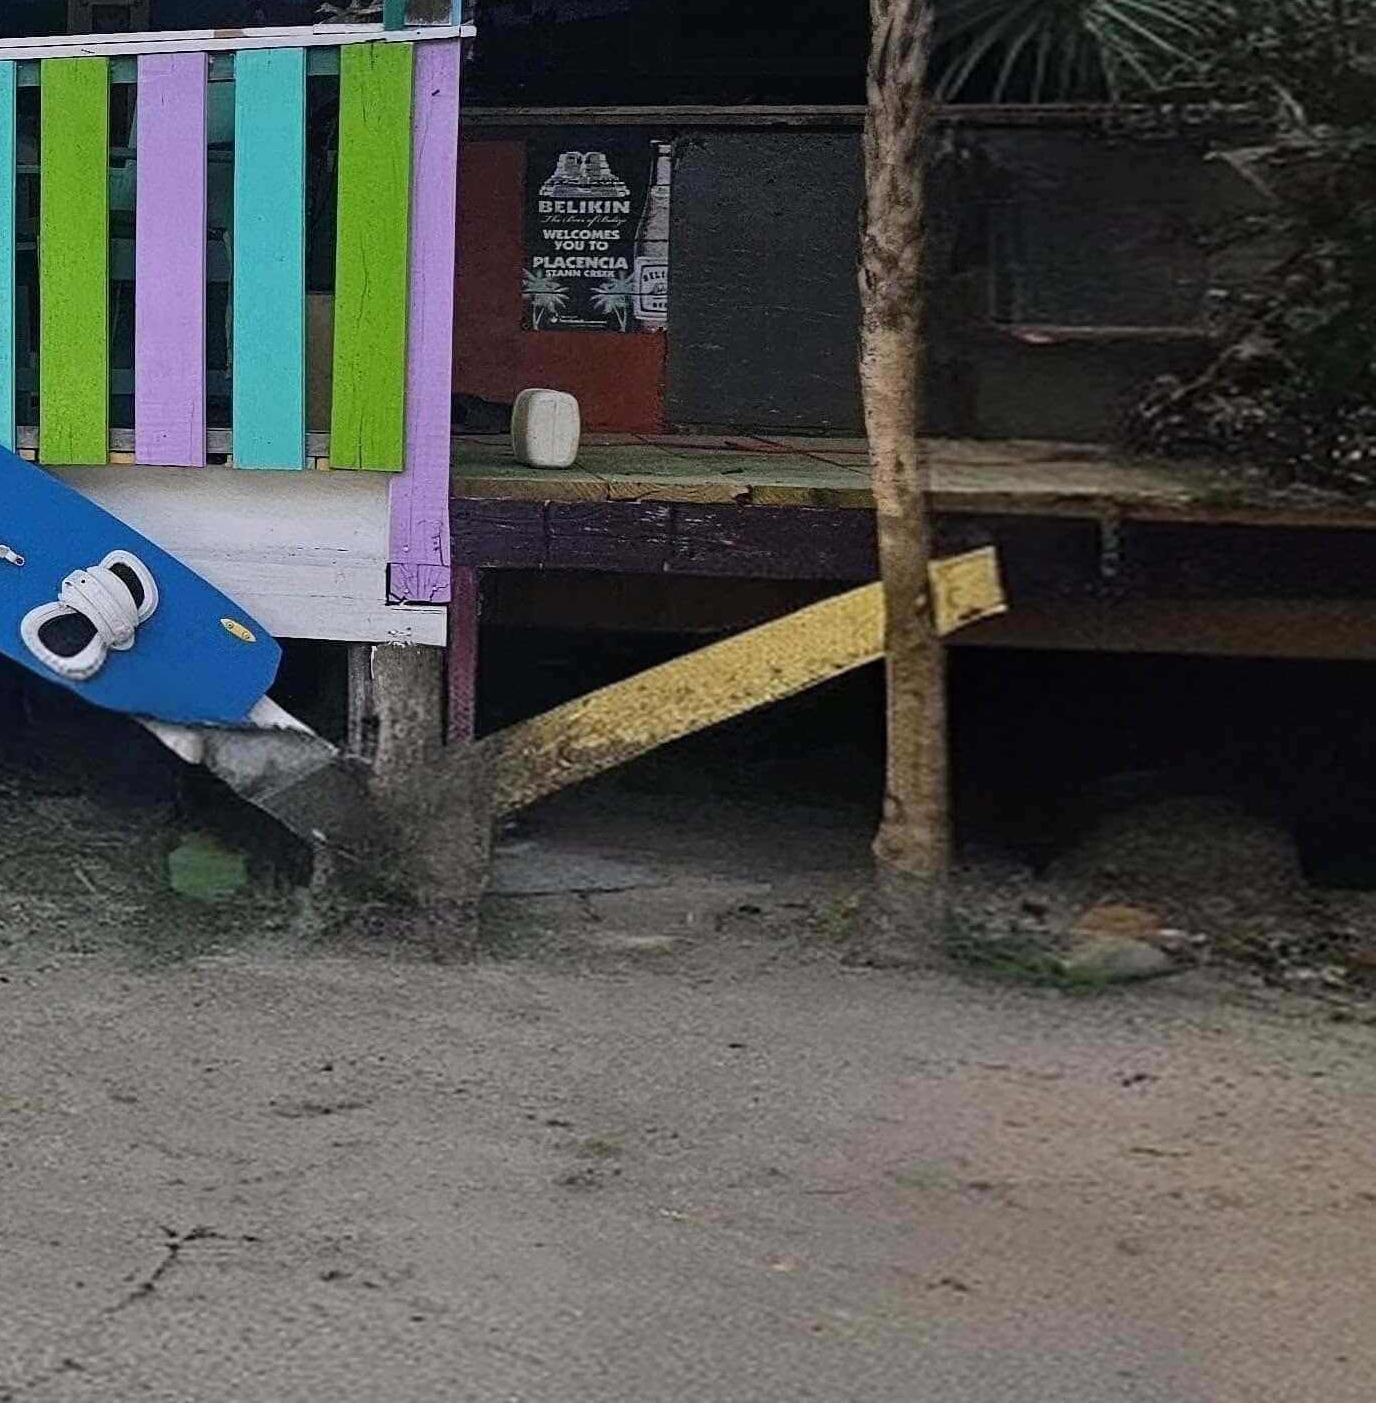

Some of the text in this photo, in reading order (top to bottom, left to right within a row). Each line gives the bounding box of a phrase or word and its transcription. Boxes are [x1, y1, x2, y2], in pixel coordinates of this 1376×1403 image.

[538, 200, 630, 214] BELIKIN
[542, 229, 620, 240] WELCOMES
[554, 240, 609, 251] YOU TO
[533, 256, 628, 269] PLACENCIA
